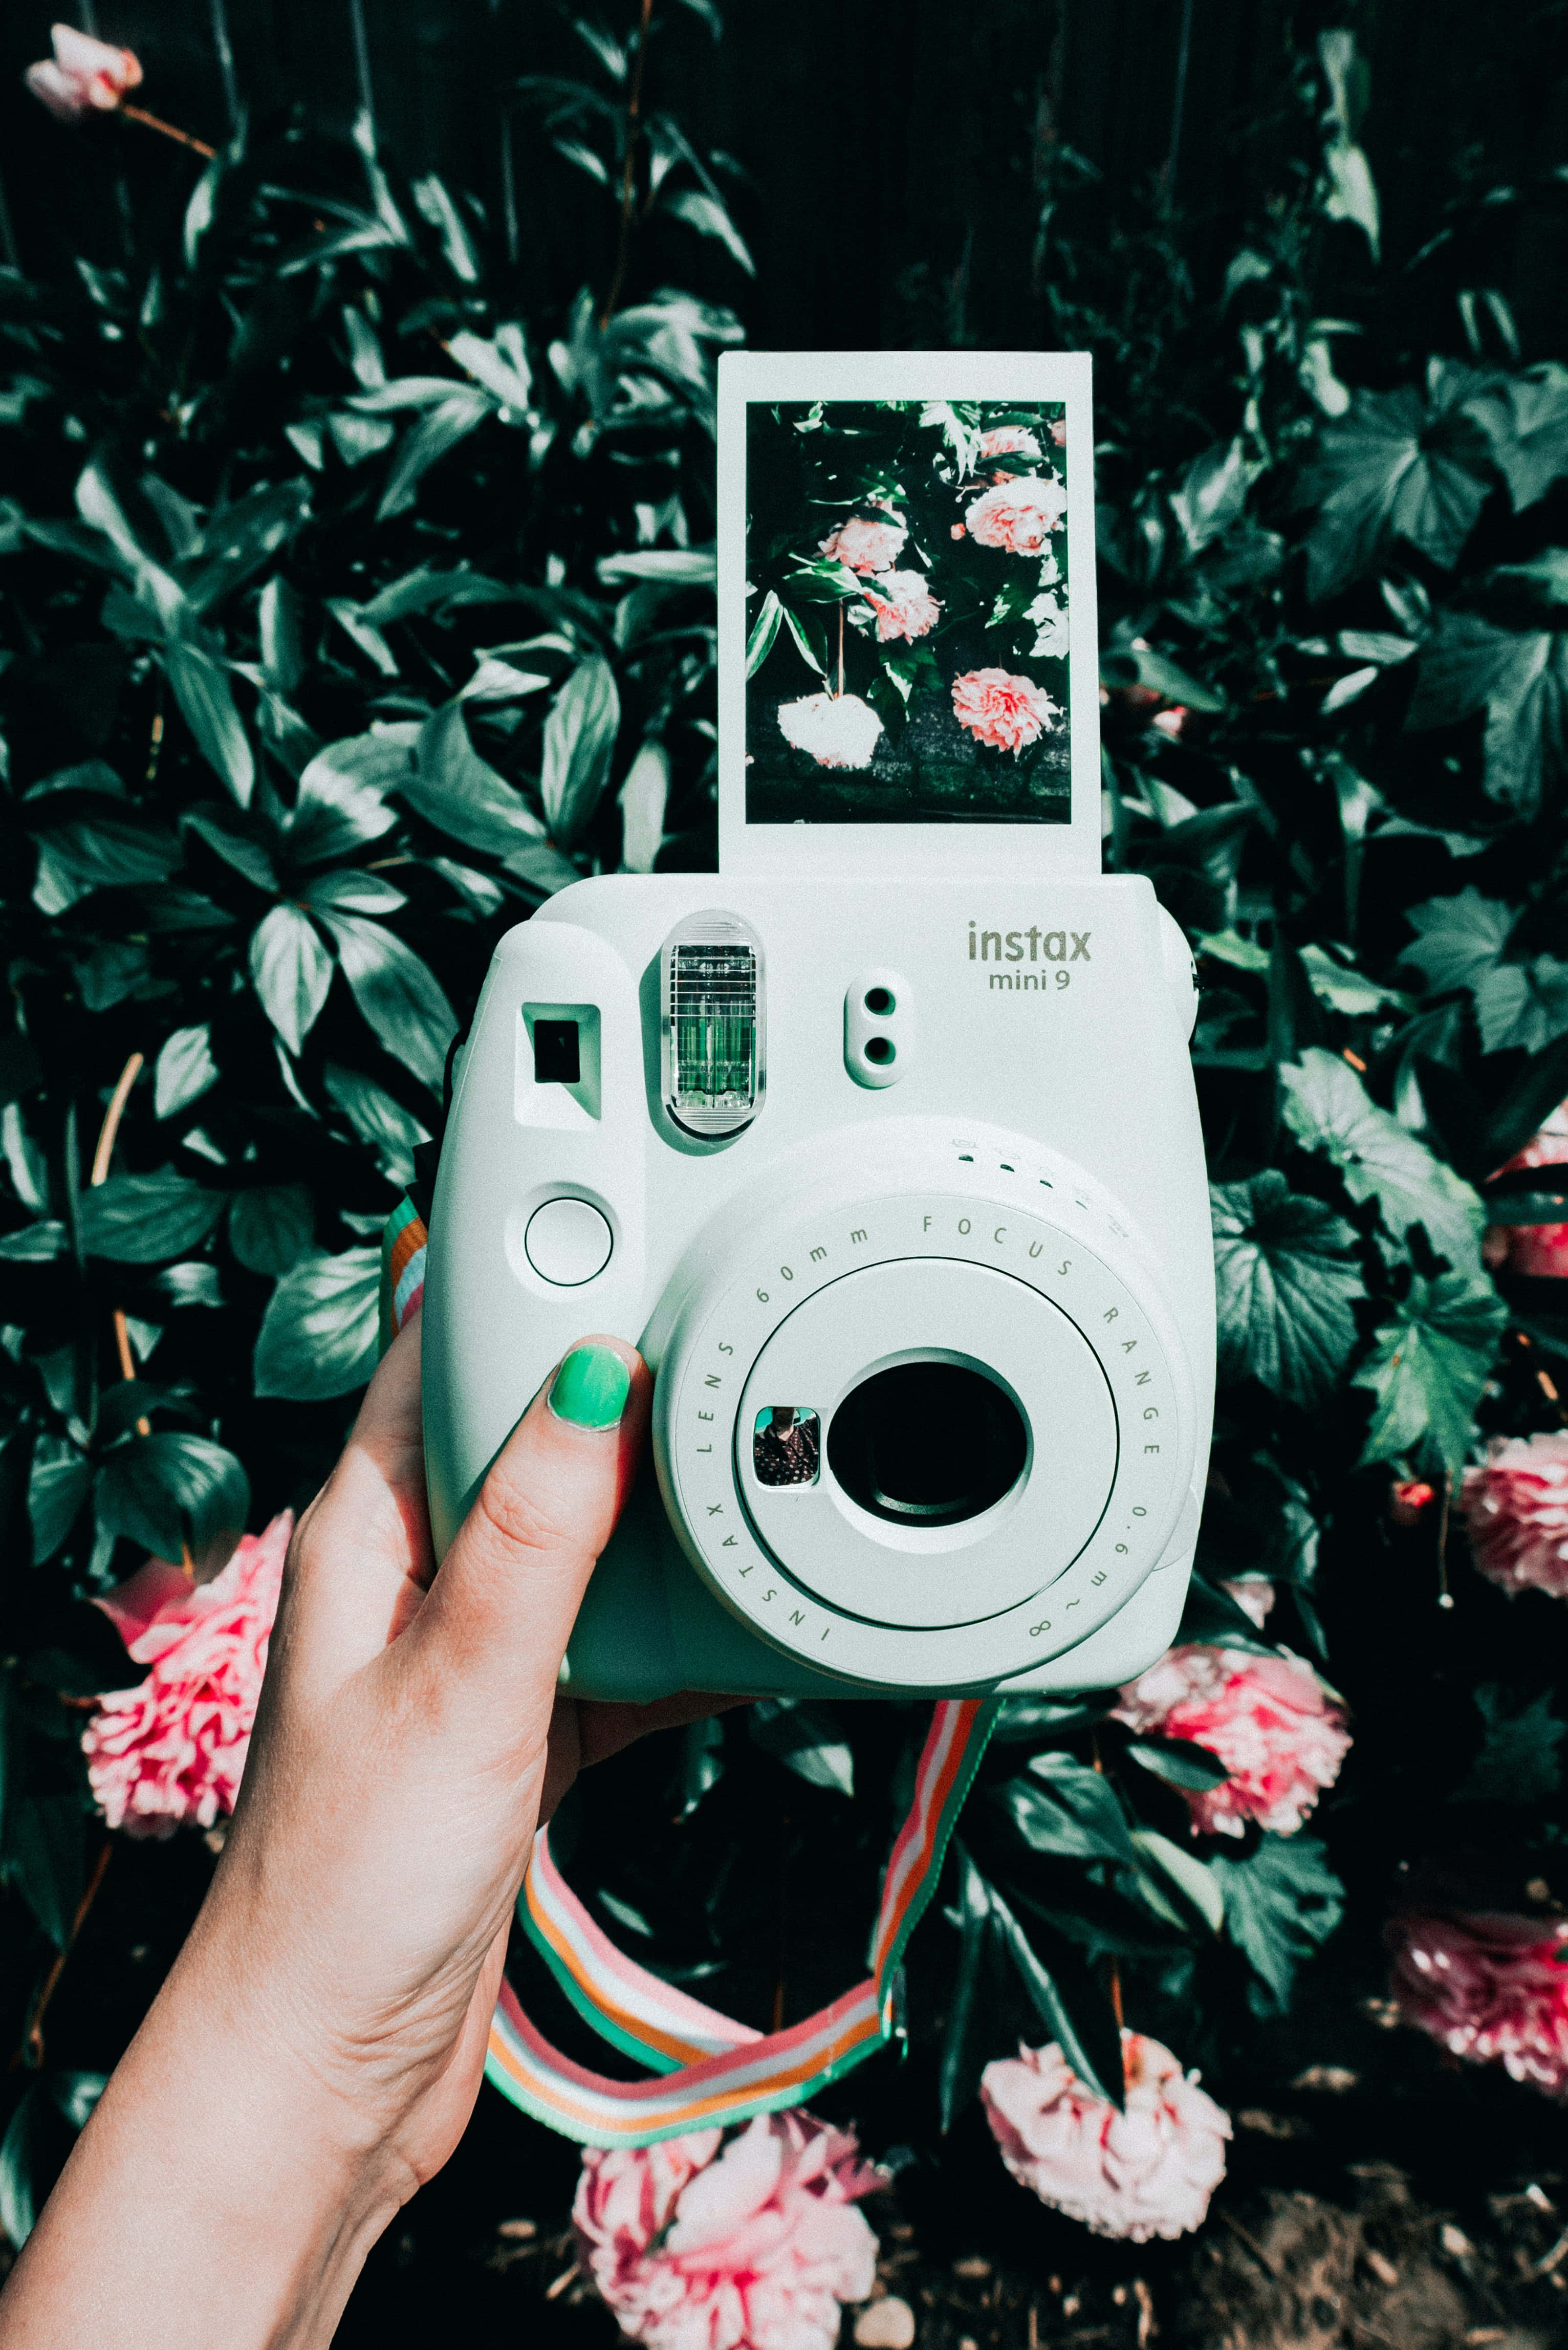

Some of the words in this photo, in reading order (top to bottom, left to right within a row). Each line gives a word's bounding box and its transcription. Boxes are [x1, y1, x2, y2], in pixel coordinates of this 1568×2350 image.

[968, 920, 1092, 962] instax
[989, 969, 1047, 990] mini
[1055, 970, 1070, 990] 9
[756, 1228, 868, 1303] 60mm
[923, 1215, 1072, 1276] FOCUS
[696, 1341, 733, 1453] LENS
[1103, 1307, 1160, 1454] RANGE
[706, 1503, 830, 1641] INSTAX
